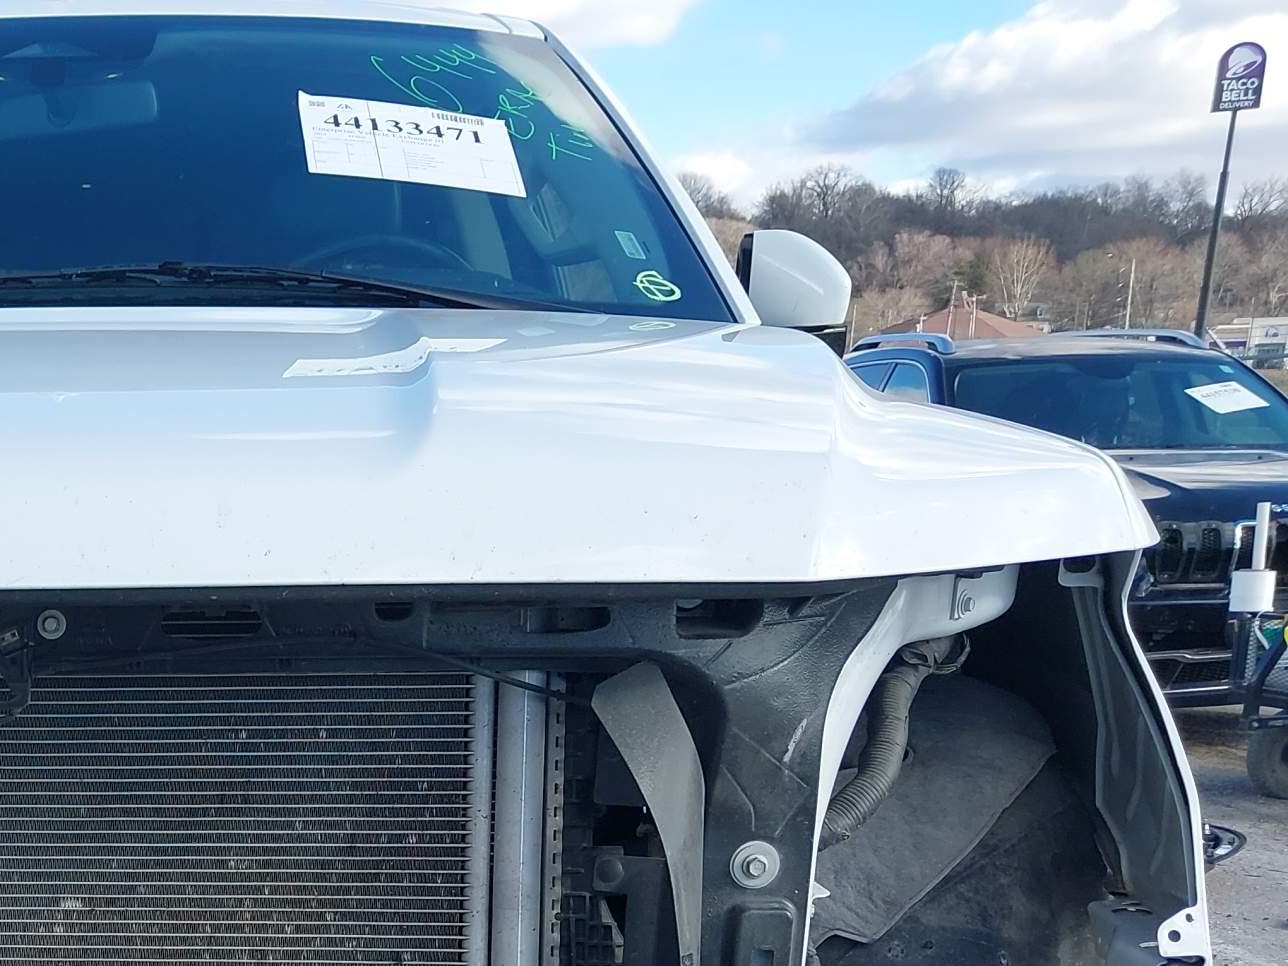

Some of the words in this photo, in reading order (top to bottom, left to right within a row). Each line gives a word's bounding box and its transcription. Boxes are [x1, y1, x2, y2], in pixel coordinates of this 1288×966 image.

[1221, 78, 1258, 90] TACO
[1221, 89, 1256, 102] BELL
[1219, 101, 1254, 109] DELIVERY
[323, 113, 481, 144] 44133471
